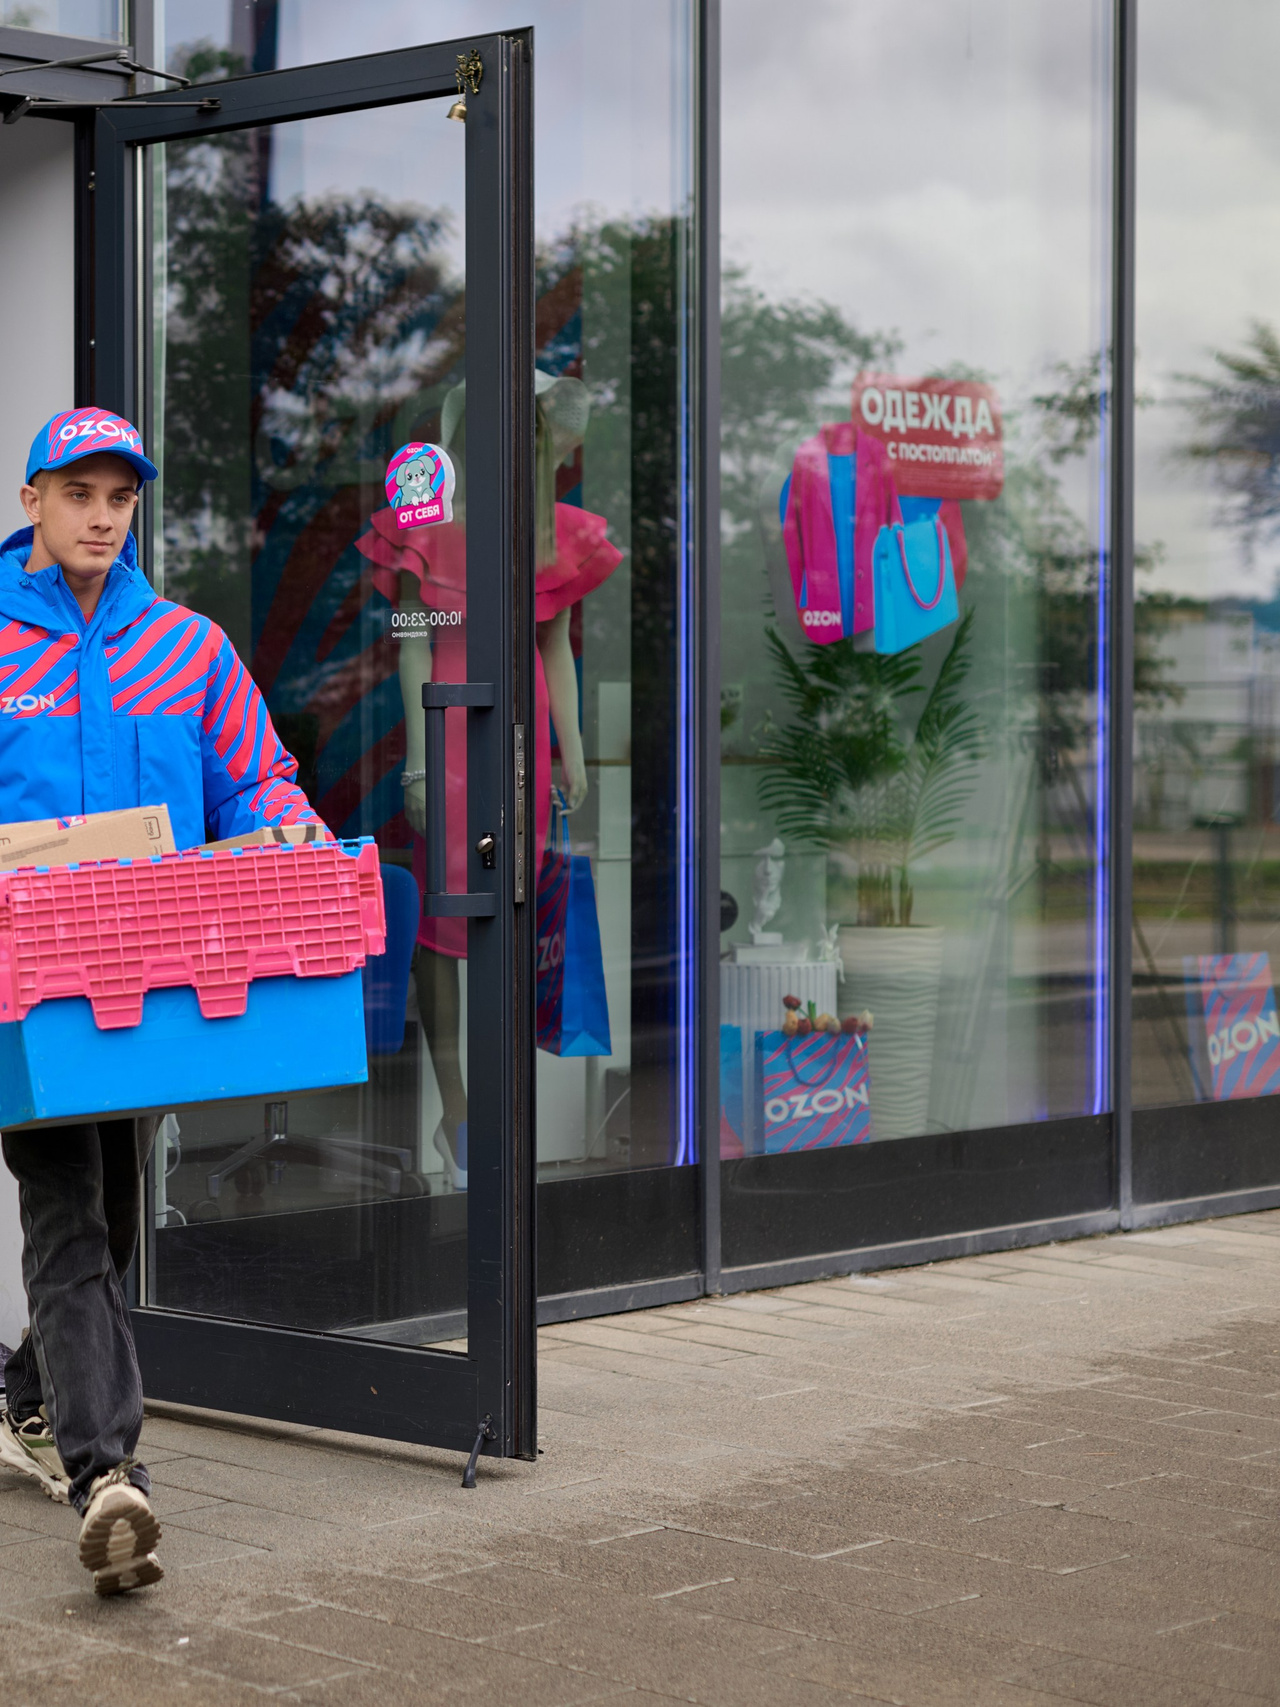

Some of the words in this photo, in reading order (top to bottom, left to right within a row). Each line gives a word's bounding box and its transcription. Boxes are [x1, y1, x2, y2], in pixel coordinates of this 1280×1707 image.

[861, 387, 995, 439] ОДЕЖДА
[60, 420, 134, 448] OZON
[399, 510, 413, 523] ОТ
[417, 504, 440, 520] СЕБЯ
[803, 610, 841, 627] OZON
[1207, 1010, 1280, 1066] OZON
[765, 1082, 870, 1123] OZON
